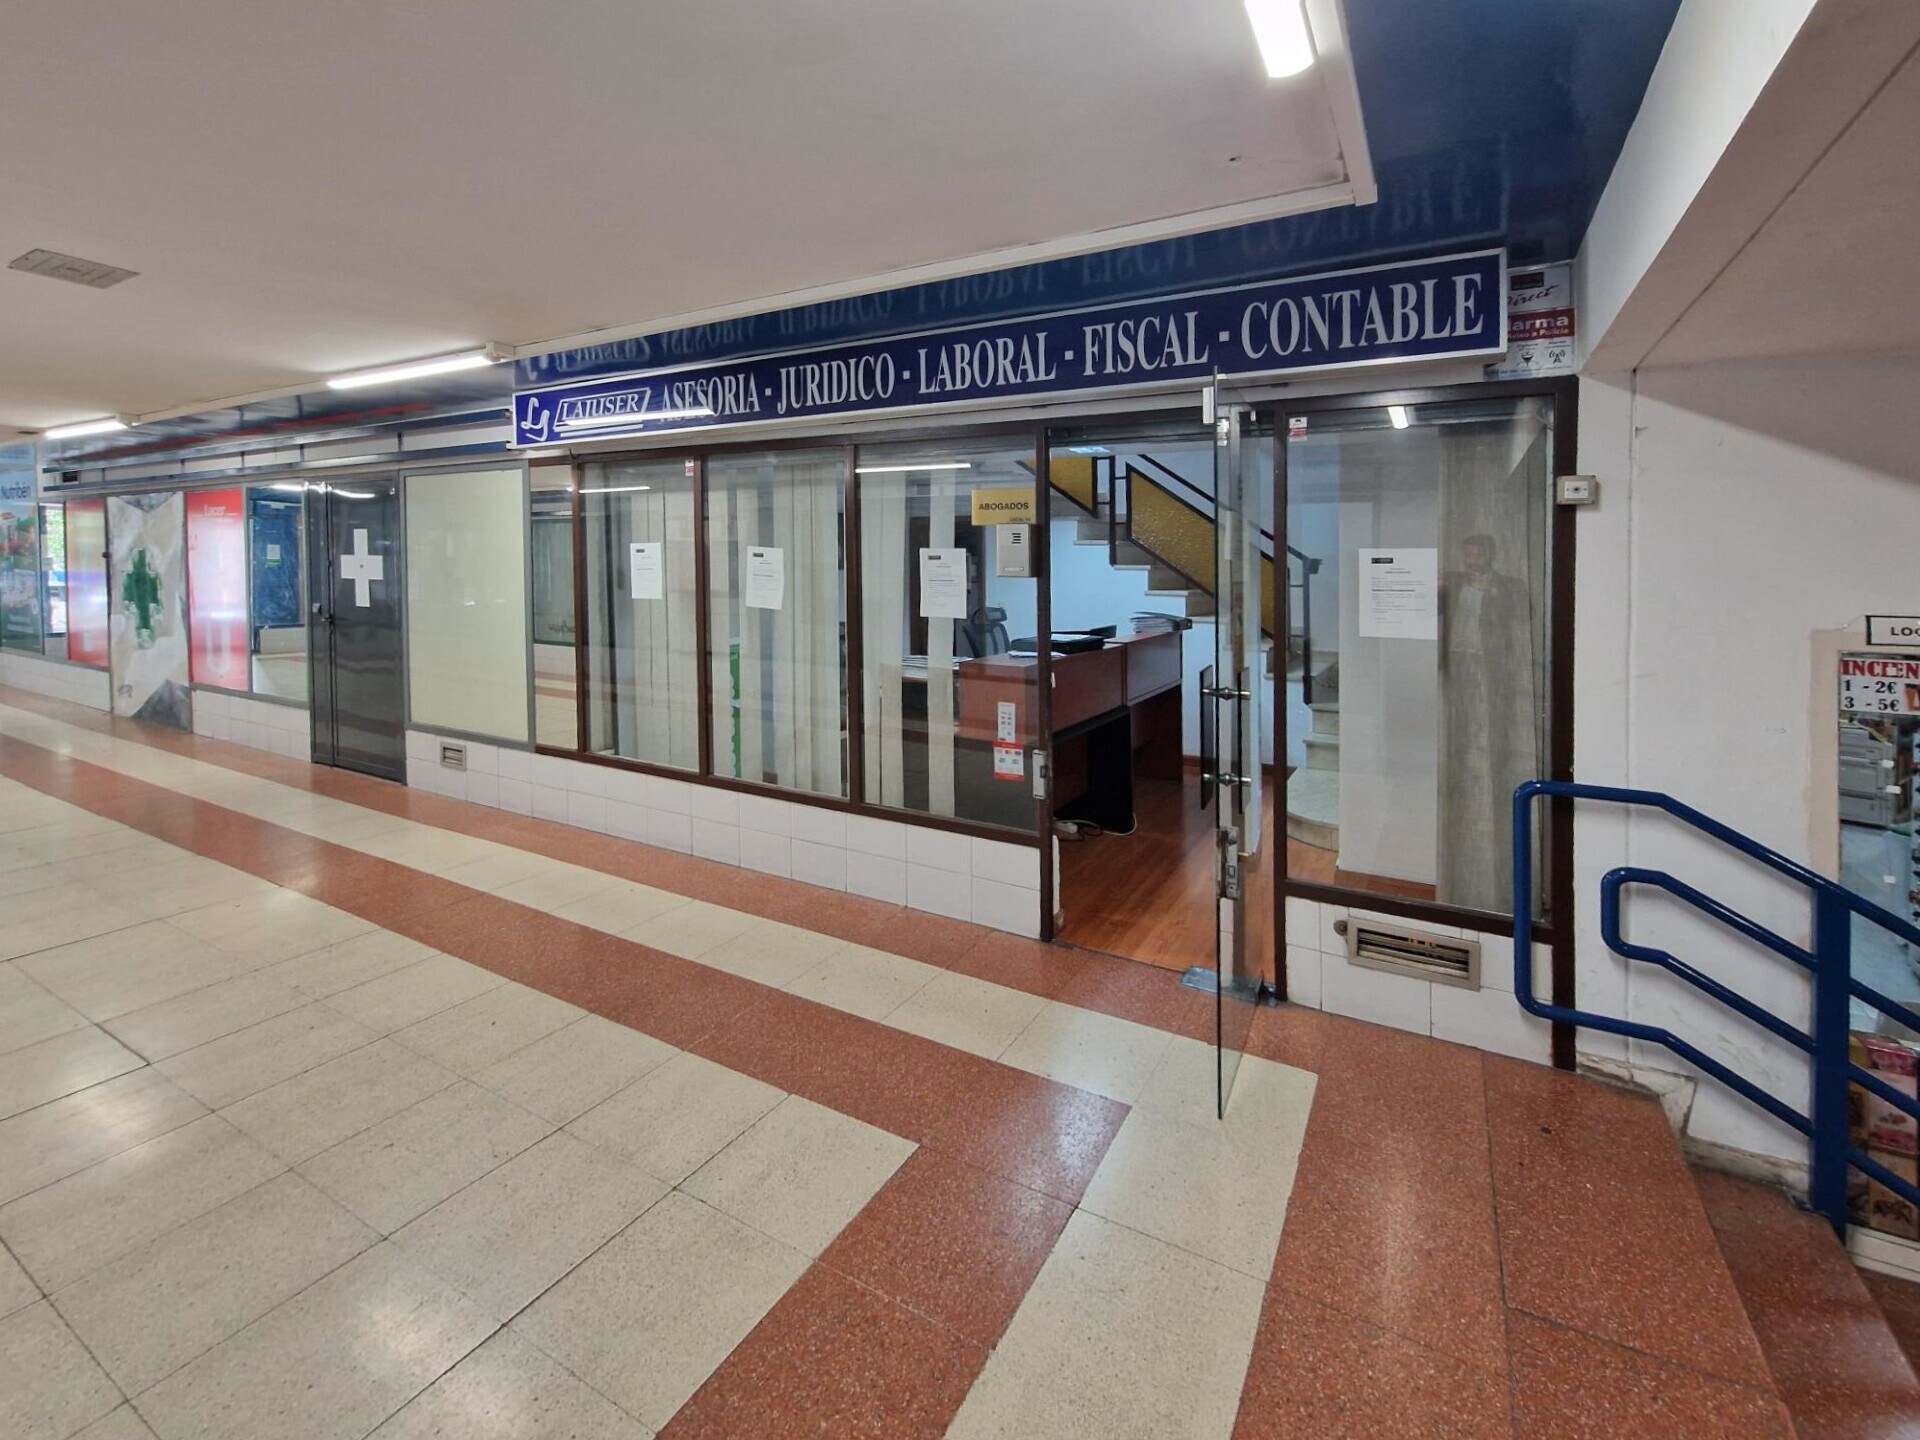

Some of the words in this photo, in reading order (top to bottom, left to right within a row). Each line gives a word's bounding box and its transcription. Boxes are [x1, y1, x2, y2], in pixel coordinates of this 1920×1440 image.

[660, 372, 760, 423] ASESORIA
[777, 352, 895, 414] JURIDICO
[918, 332, 1057, 394] LABORAL
[1082, 311, 1209, 376] FISCAL
[1241, 273, 1484, 359] CONTABLE
[561, 393, 639, 421] LAJUSER
[979, 502, 1029, 511] ABOGADOS
[1843, 680, 1852, 691] 1
[1875, 681, 1897, 694] 2€
[1844, 697, 1855, 709] 3
[1878, 699, 1900, 712] 5€
